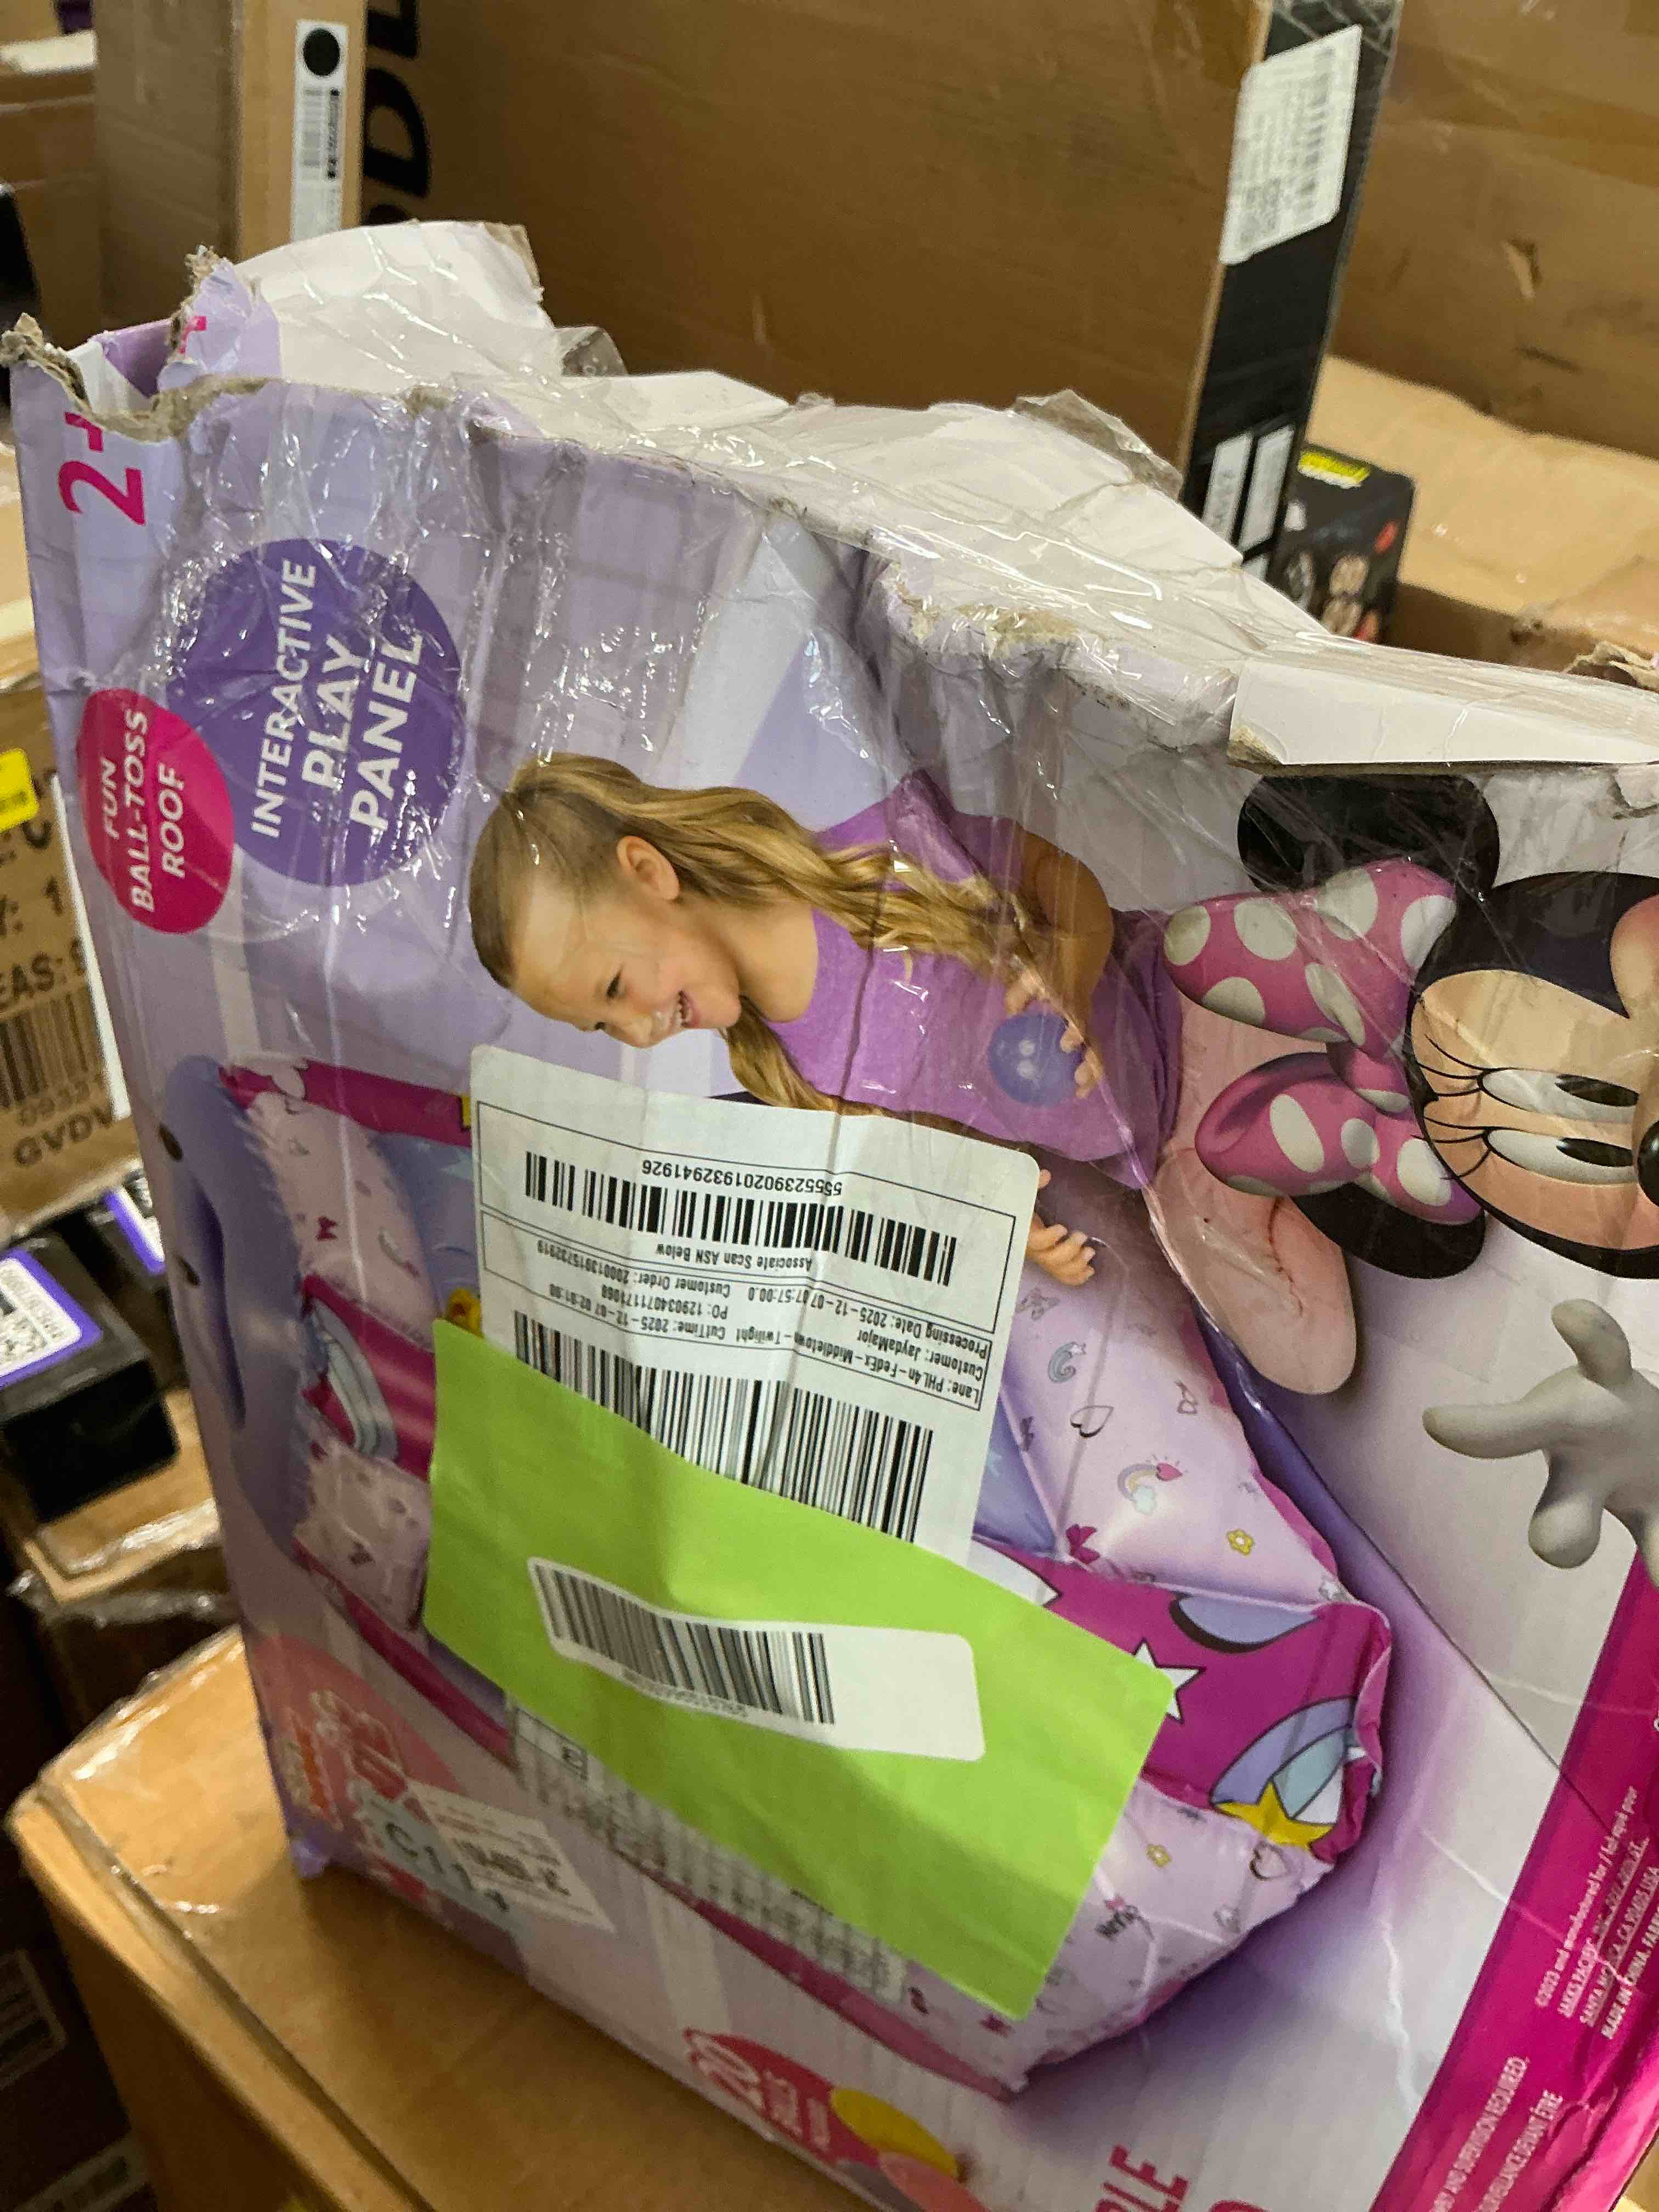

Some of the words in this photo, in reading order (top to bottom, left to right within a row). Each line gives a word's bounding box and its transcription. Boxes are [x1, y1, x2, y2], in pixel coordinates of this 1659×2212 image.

[251, 558, 317, 839] INTERACTIVE
[302, 633, 364, 791] PLAY
[349, 633, 424, 831] PANEL
[100, 757, 120, 840] FUN
[124, 708, 155, 913] BALL-TOSS
[158, 763, 185, 878] ROOF
[656, 1243, 690, 1261] Below
[695, 1248, 720, 1266] ASN
[724, 1252, 752, 1269] Scan
[757, 1255, 812, 1272] Associate
[633, 1272, 670, 1290] Order:
[675, 1277, 731, 1298] Customer
[707, 1304, 729, 1319] PO:
[674, 1320, 726, 1340] CutTime:
[891, 1316, 922, 1339] Date:
[857, 1329, 921, 1361] JaydaMajor
[926, 1322, 988, 1359] Processing
[925, 1348, 984, 1381] Customer:
[948, 1379, 980, 1404] Lane:
